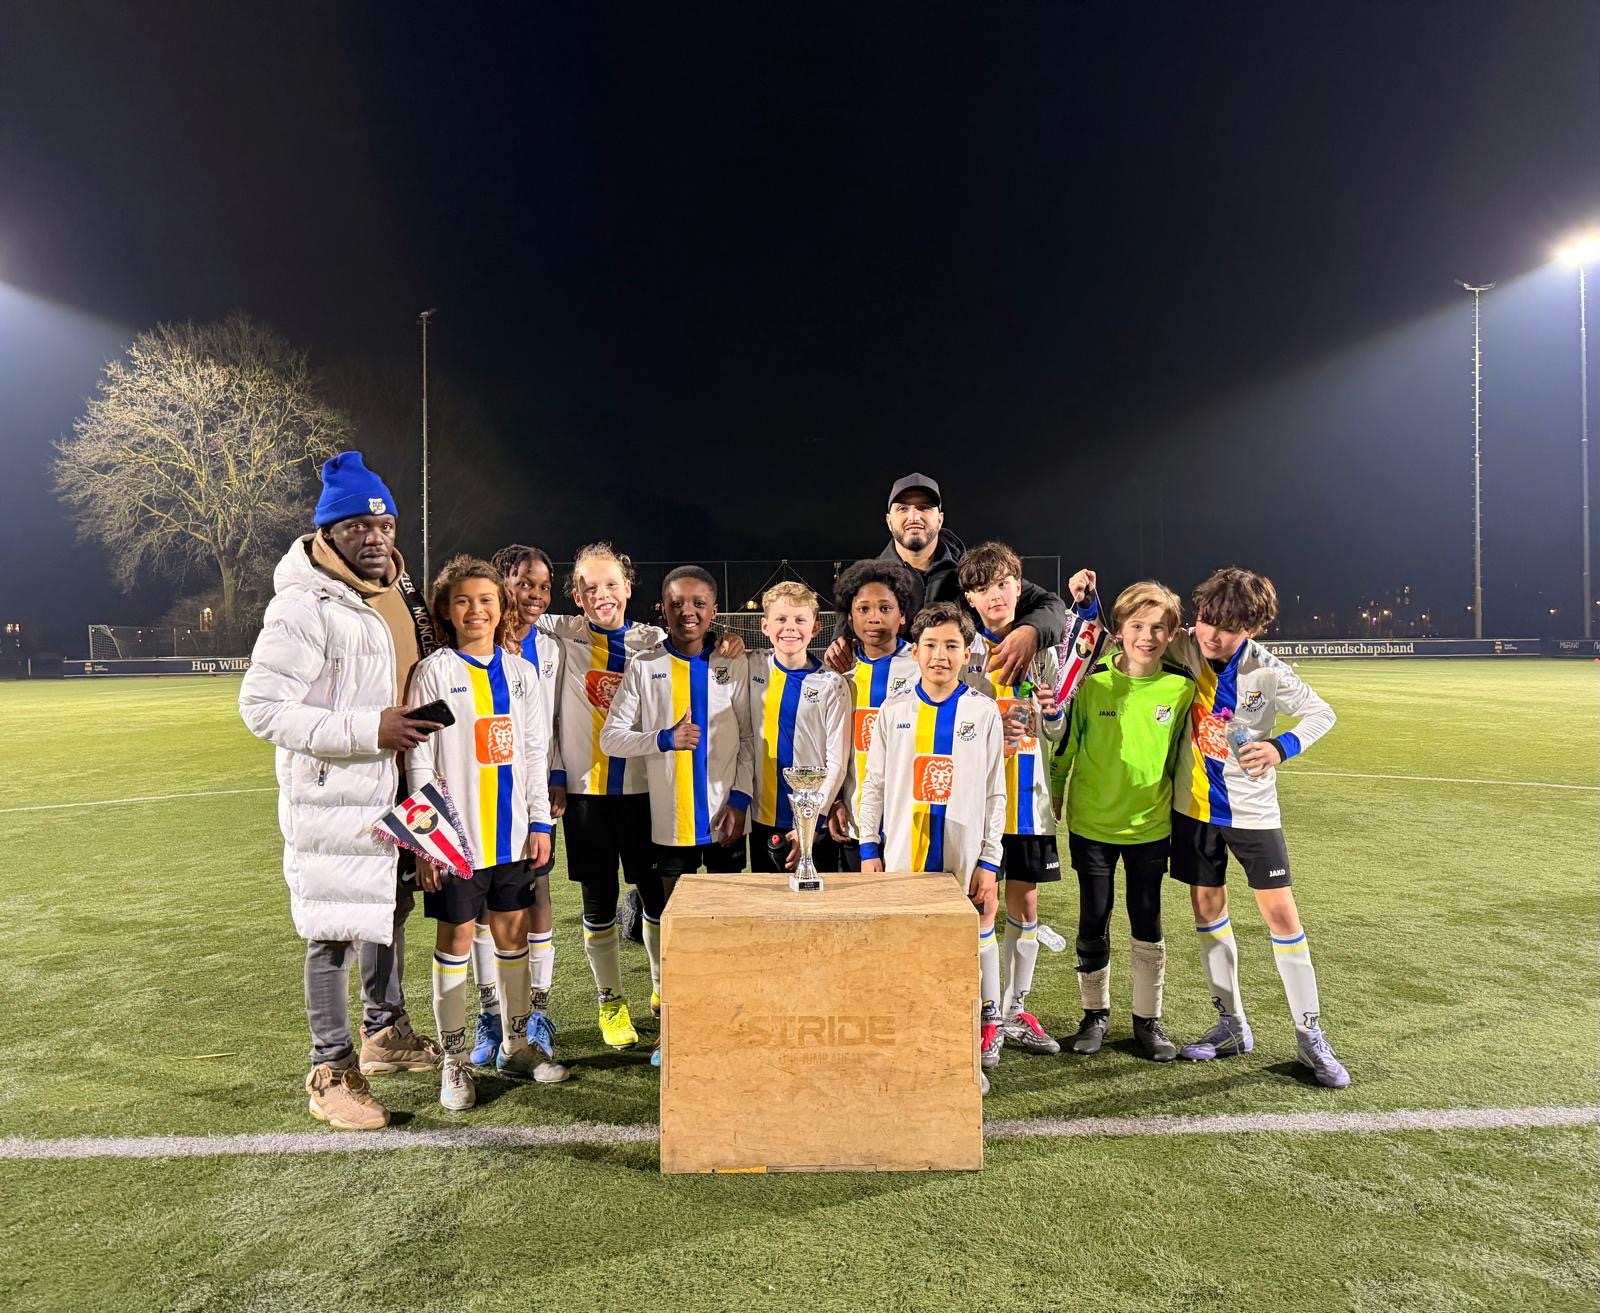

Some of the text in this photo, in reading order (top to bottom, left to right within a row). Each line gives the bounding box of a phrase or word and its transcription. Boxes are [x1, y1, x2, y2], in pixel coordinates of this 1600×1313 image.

[412, 606, 434, 656] MONCLE
[1272, 646, 1292, 655] aan
[1295, 644, 1309, 655] de
[1311, 643, 1414, 657] vriendschapsband
[192, 659, 252, 673] Hup Wille
[450, 686, 468, 694] JAKO
[1269, 869, 1286, 878] JAKO
[737, 1015, 896, 1047] STRIDE
